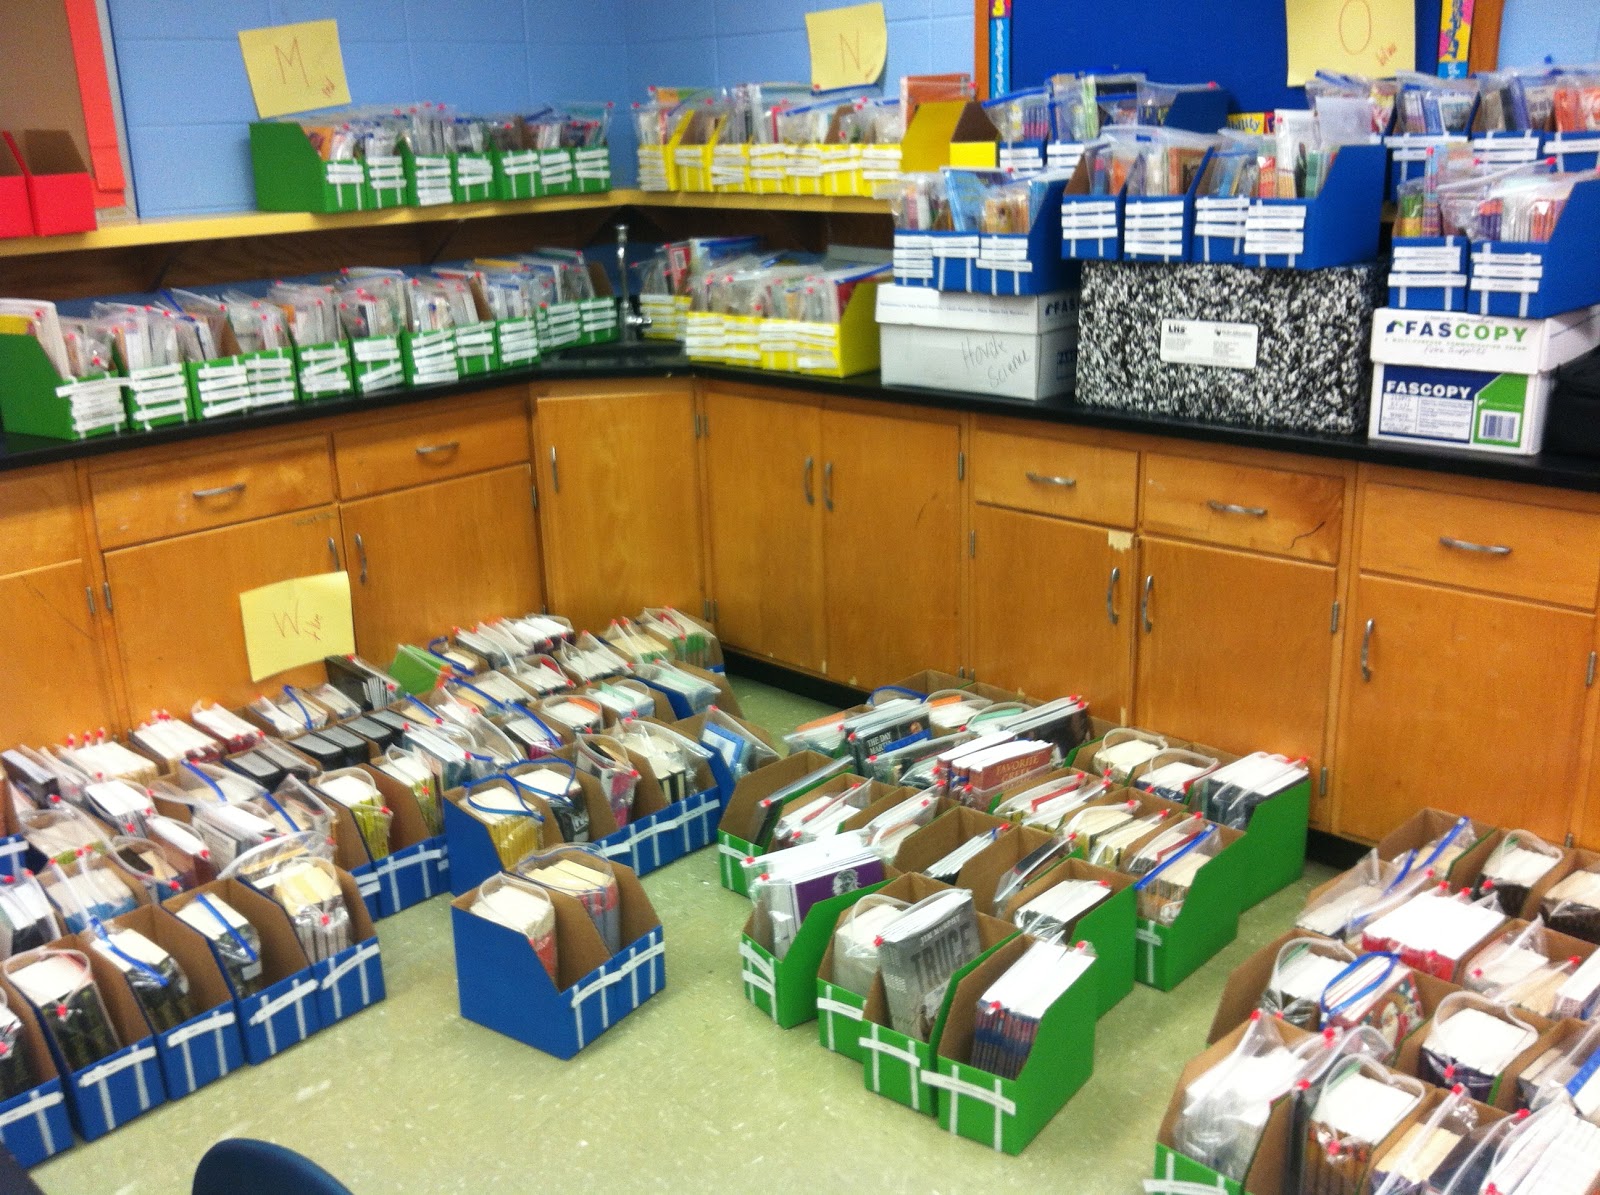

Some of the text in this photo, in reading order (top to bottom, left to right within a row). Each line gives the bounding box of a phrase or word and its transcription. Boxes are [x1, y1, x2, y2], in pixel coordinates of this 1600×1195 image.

[1339, 0, 1371, 55] O
[274, 36, 310, 87] M
[839, 29, 861, 73] N
[1405, 320, 1528, 342] FASCOPY
[1386, 381, 1471, 399] FASCOPY
[272, 599, 300, 638] W
[866, 731, 891, 748] THE DAY
[996, 756, 1040, 776] FAVORITE
[919, 932, 934, 947] JIM
[910, 921, 974, 994] TRUCE
